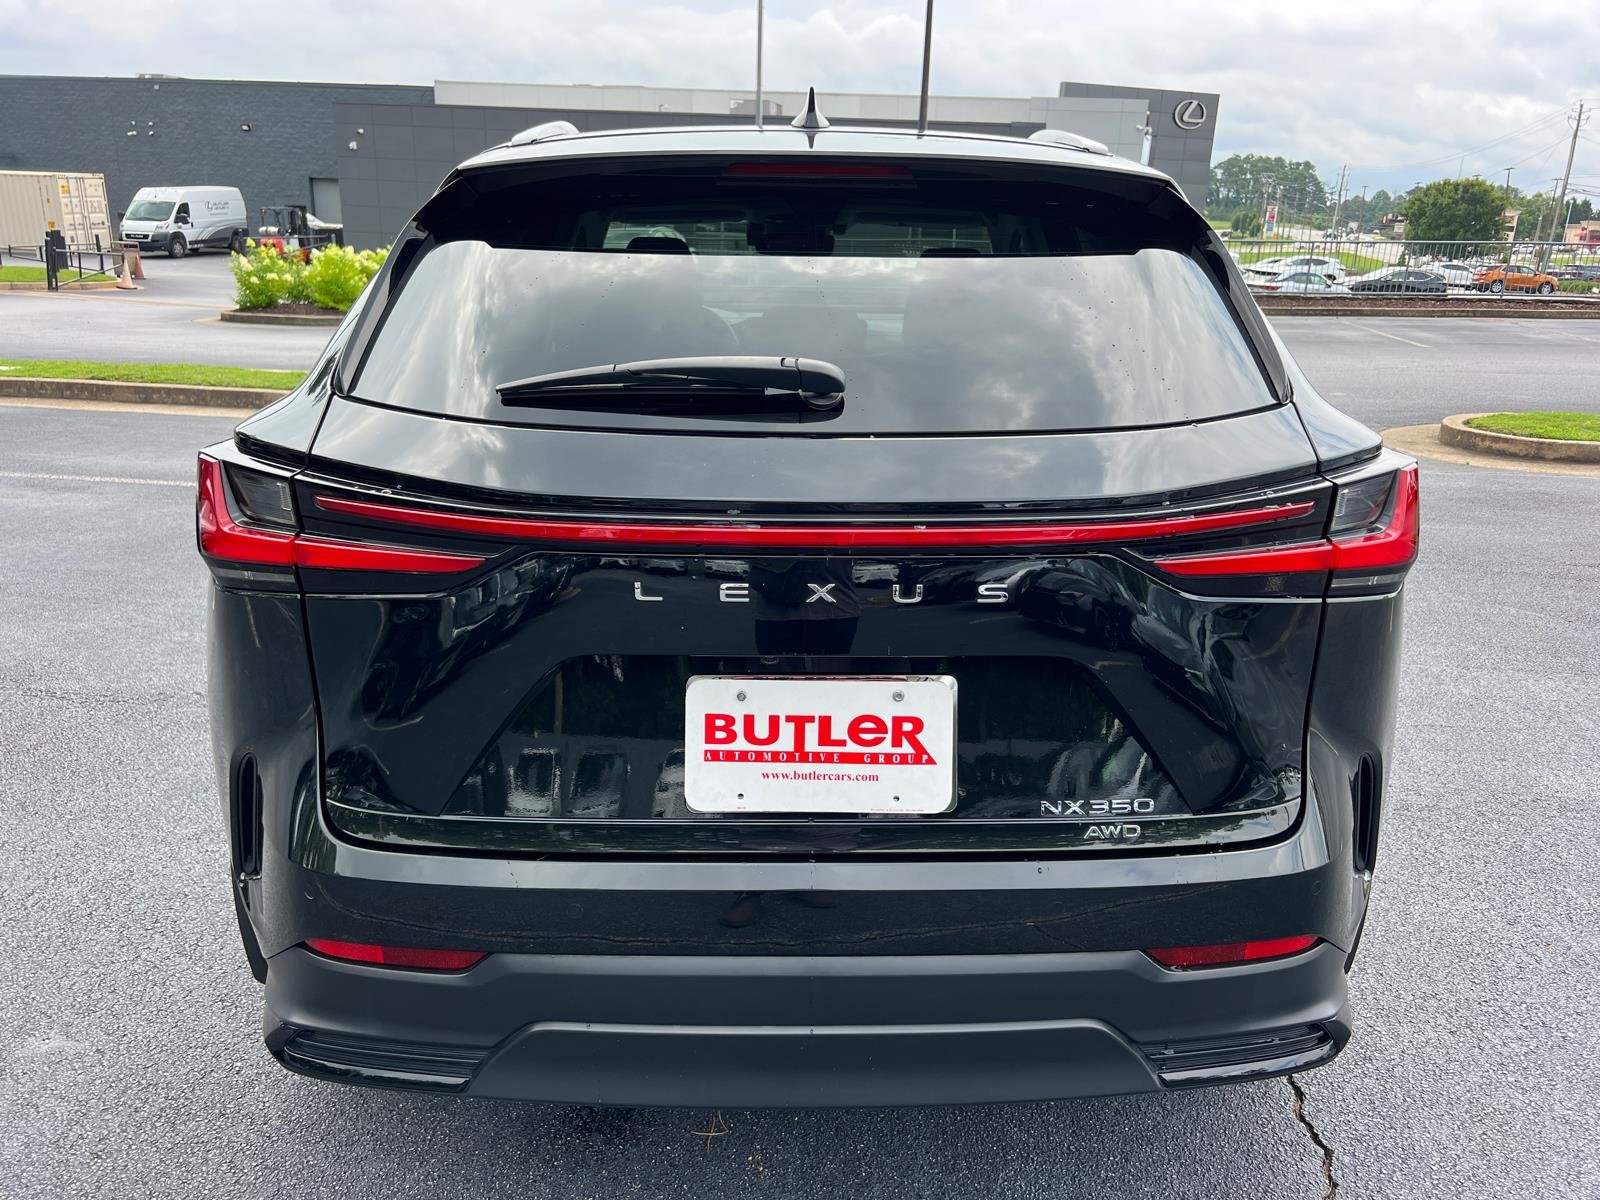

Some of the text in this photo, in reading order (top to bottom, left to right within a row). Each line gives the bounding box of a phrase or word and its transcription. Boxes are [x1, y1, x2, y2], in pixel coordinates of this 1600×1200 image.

[634, 581, 1009, 604] LEXUS
[704, 750, 930, 764] AUTOMOTIVE GROUP
[761, 770, 879, 782] www.butlercars.com
[1083, 824, 1141, 839] AWD
